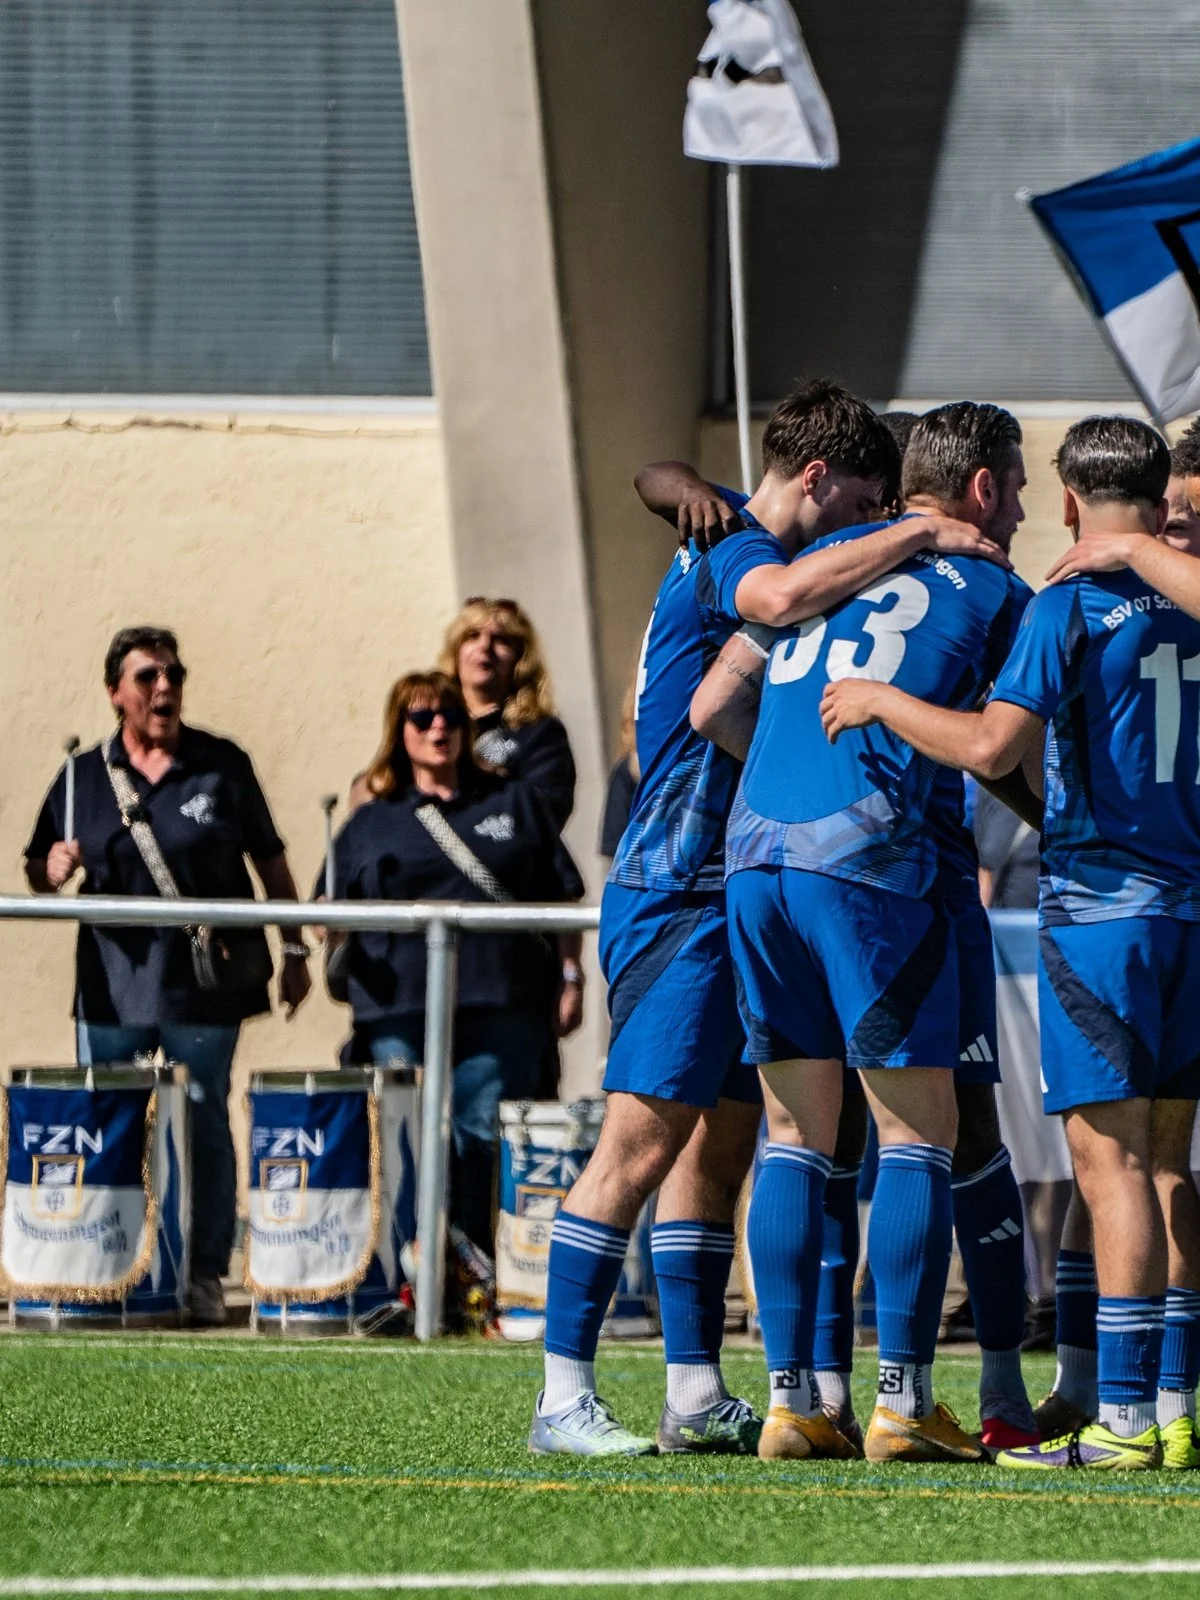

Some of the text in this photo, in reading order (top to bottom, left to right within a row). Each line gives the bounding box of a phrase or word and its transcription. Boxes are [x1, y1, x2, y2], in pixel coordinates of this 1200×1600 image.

[1102, 600, 1132, 631] BSV
[1134, 595, 1151, 613] 07
[23, 1123, 104, 1154] FZN
[252, 1126, 325, 1157] FZN
